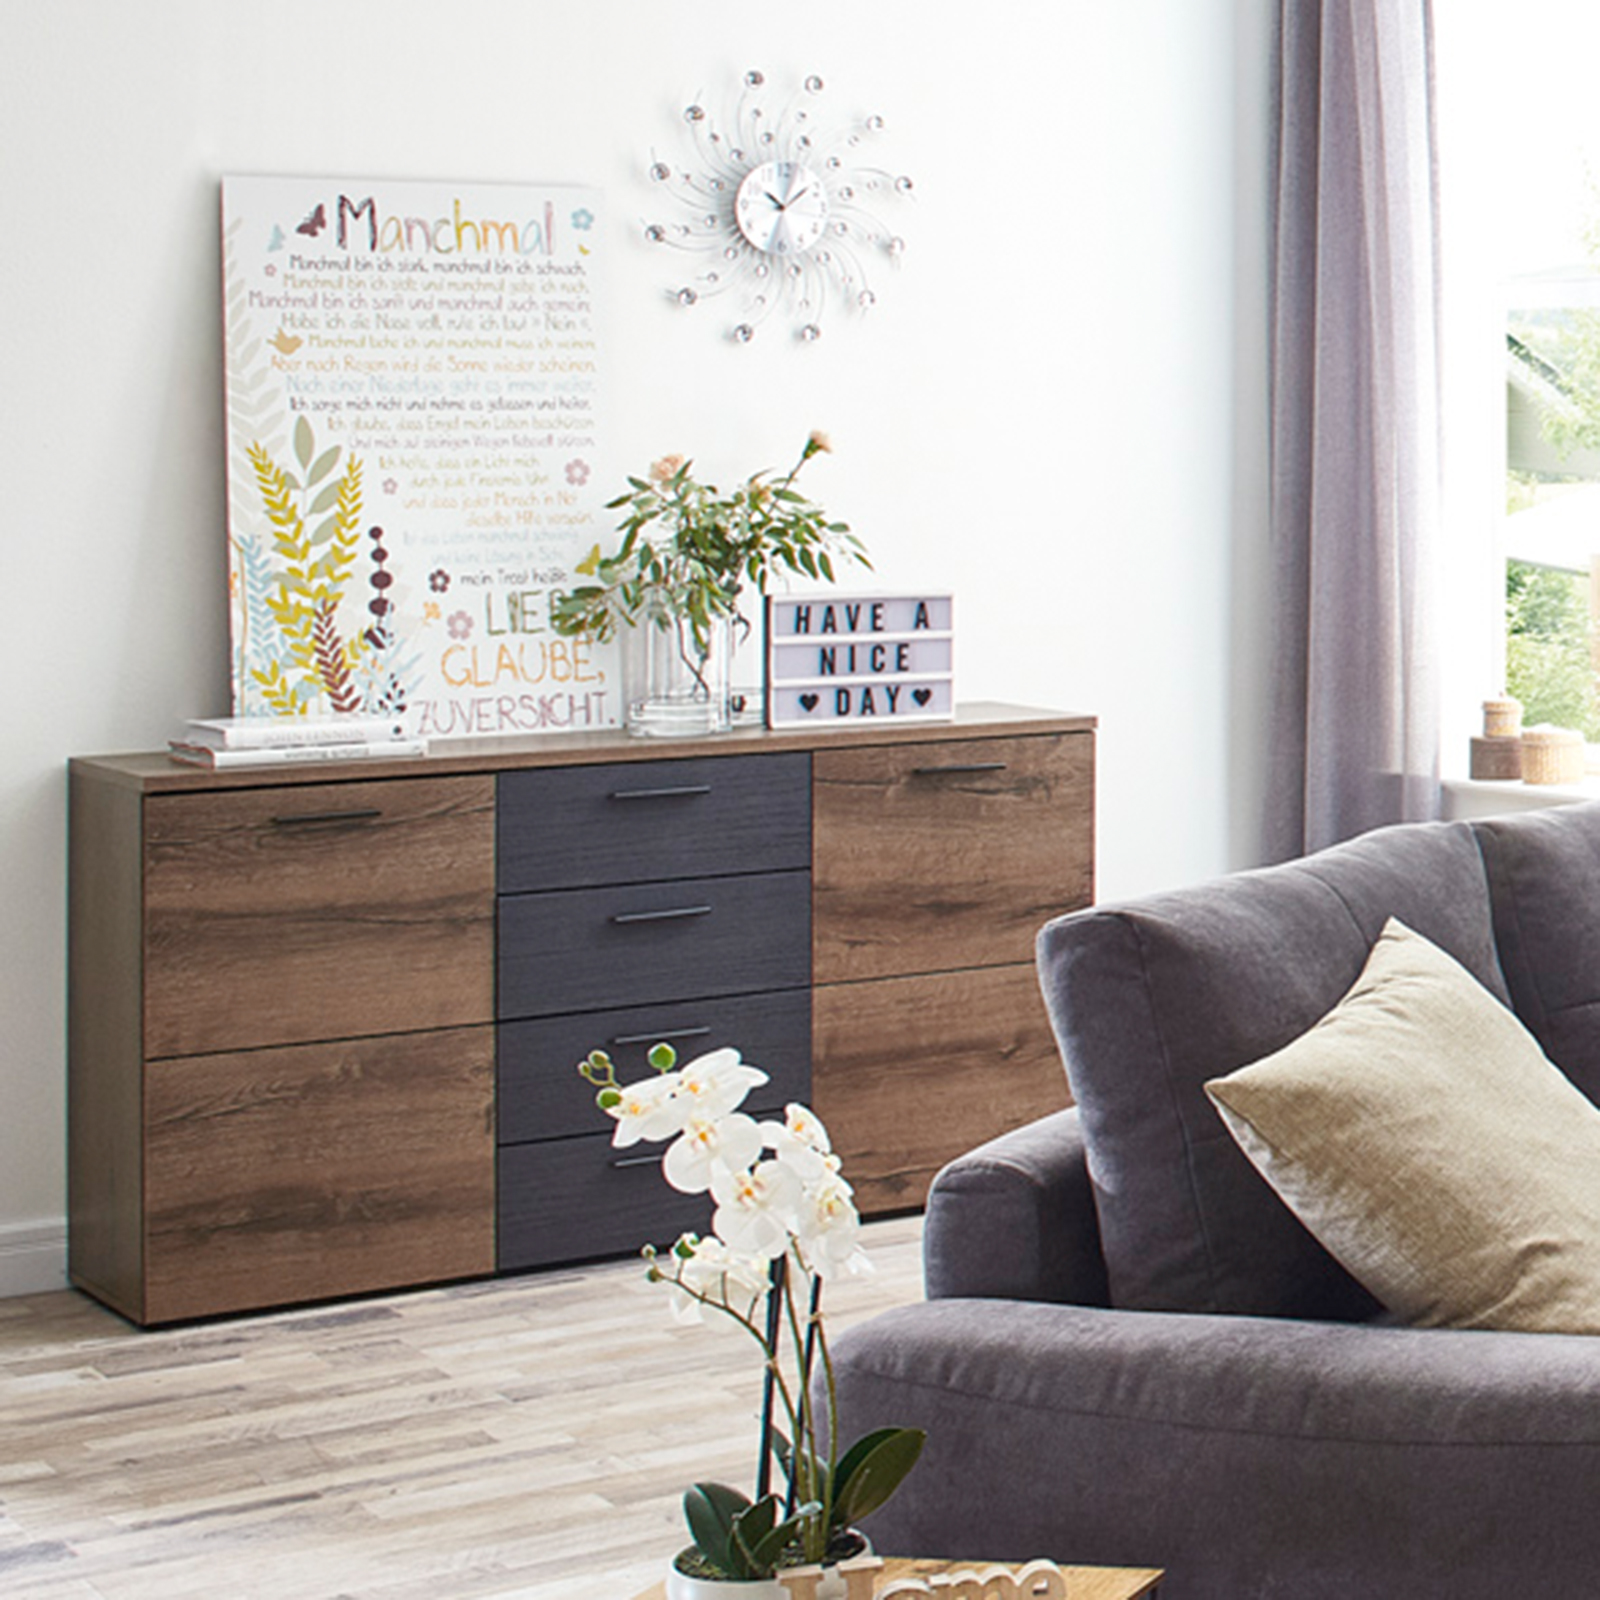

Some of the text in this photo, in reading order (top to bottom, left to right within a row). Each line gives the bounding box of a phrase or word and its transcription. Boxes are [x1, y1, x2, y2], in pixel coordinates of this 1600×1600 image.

[337, 194, 555, 255] Manchmal
[322, 291, 343, 308] bin
[348, 292, 368, 308] ich
[795, 601, 930, 634] HAVE A
[441, 639, 606, 688] GLAUBE,
[820, 643, 909, 675] NICE
[413, 691, 616, 735] ZUVERSICHT.
[835, 685, 901, 717] DAY
